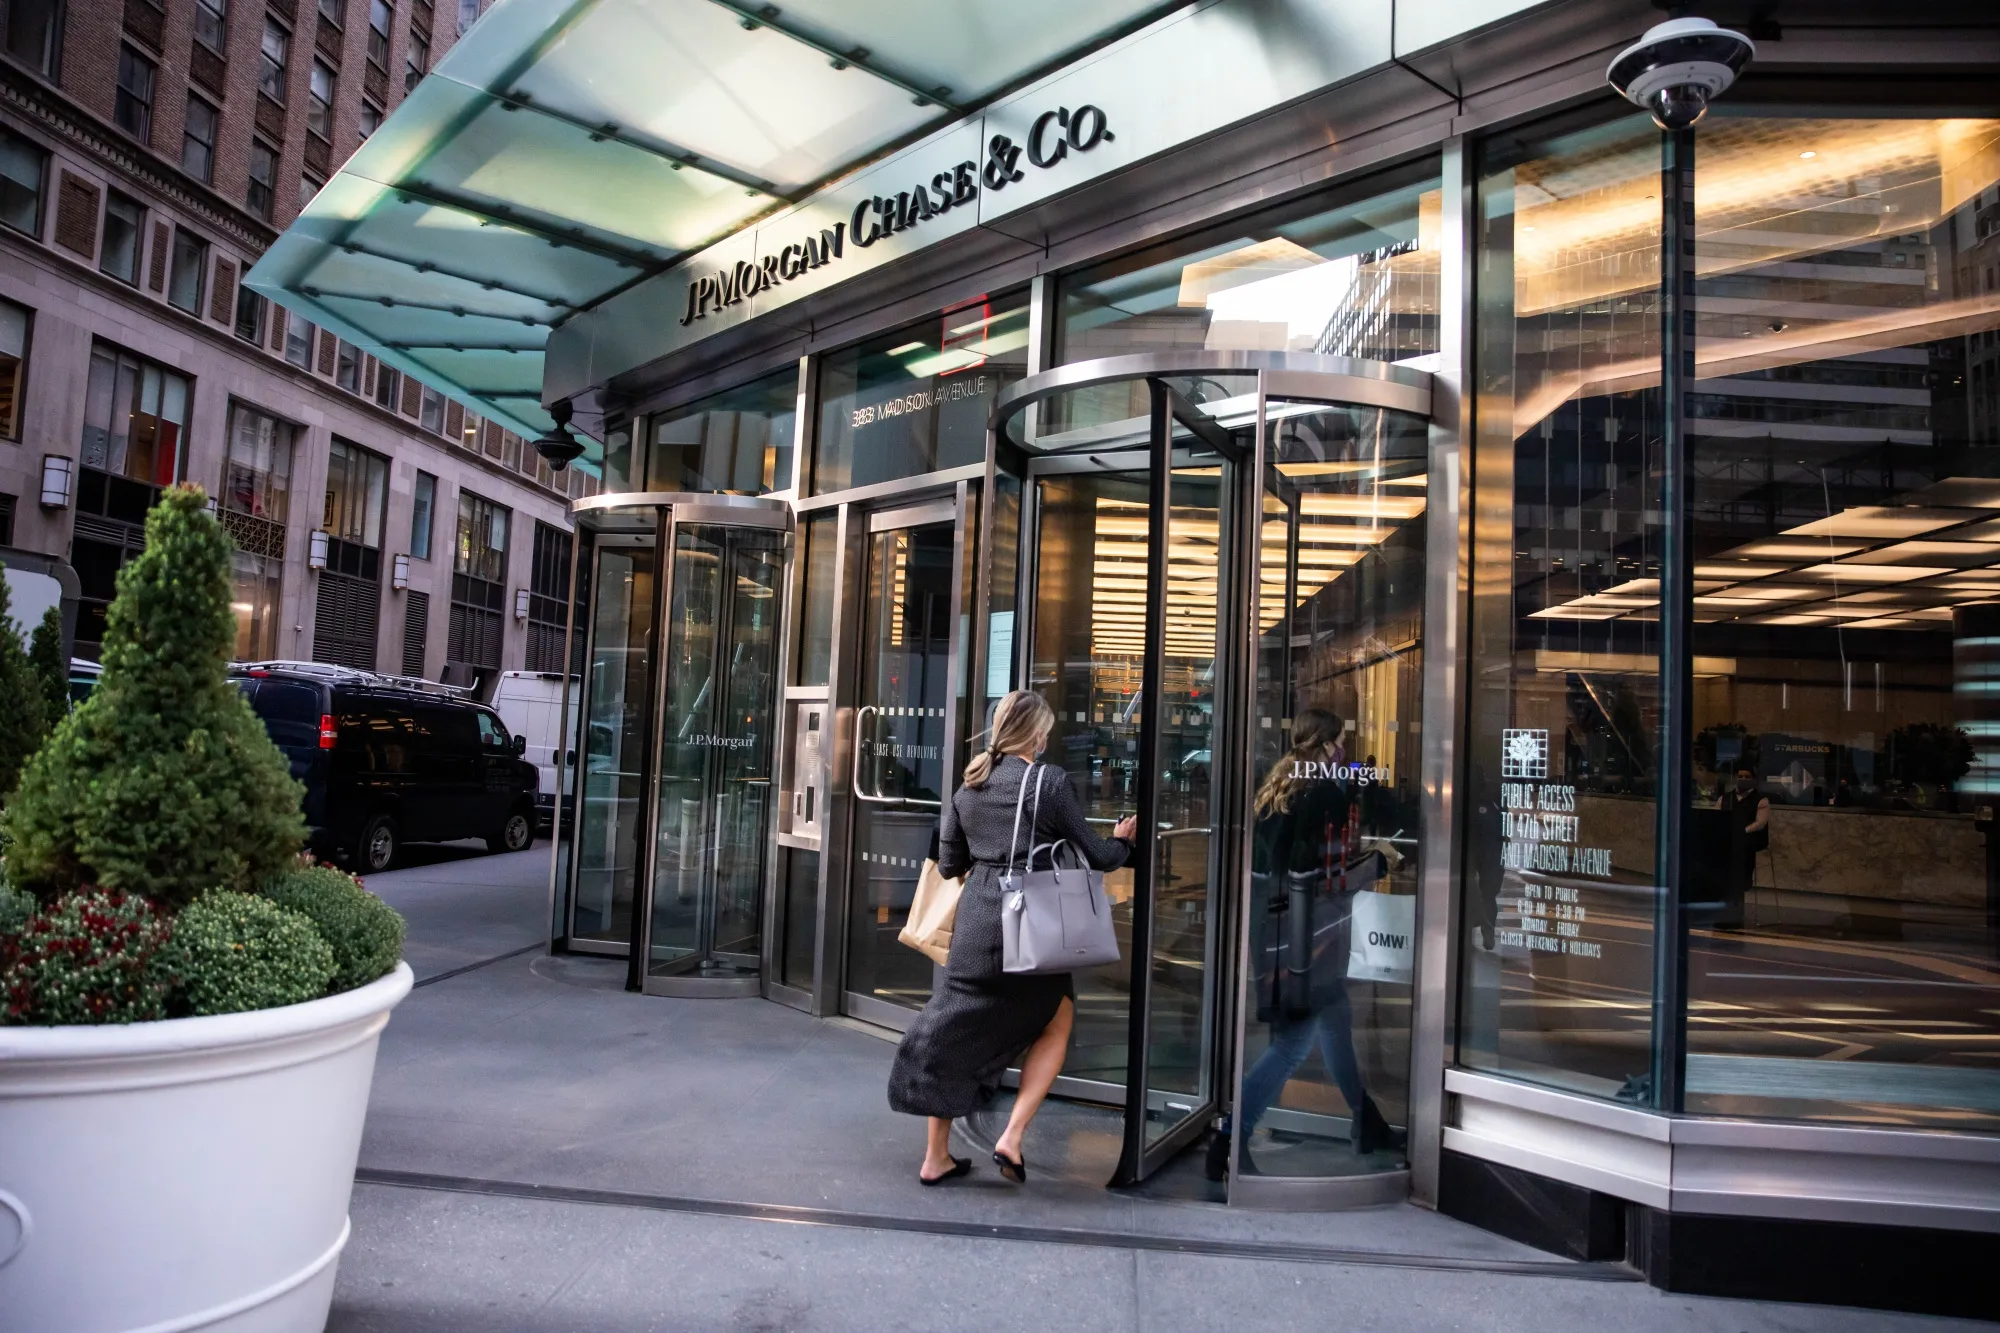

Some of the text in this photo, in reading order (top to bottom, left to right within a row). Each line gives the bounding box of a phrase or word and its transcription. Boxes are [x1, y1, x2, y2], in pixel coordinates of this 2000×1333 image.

[679, 104, 1115, 326] JPMORGAN CHASE & CO.
[851, 375, 987, 428] 383 MADISON AVENUE
[686, 734, 753, 751] J.P.Morgan
[873, 743, 889, 757] LEASE
[892, 743, 903, 758] USE
[906, 744, 938, 760] REVOLVING
[1774, 744, 1830, 753] STARBUCKS
[1288, 760, 1390, 786] J.P.Morgan
[1501, 783, 1575, 812] PUBLIC ACCESS
[1501, 812, 1579, 842] TO 47th STREET
[1500, 841, 1612, 877] AND MADISON AVENUE
[1524, 883, 1578, 903] OPEN TO PUBLIC
[1536, 902, 1546, 916] AM
[1575, 906, 1585, 921] PM
[1521, 917, 1547, 932] MONDAY
[1556, 922, 1579, 937] FRIDAY
[1368, 931, 1408, 950] OMW!
[1500, 931, 1523, 947] CLOSED
[1526, 934, 1558, 952] WEEKENDS
[1569, 940, 1601, 959] HOLIDAYS
